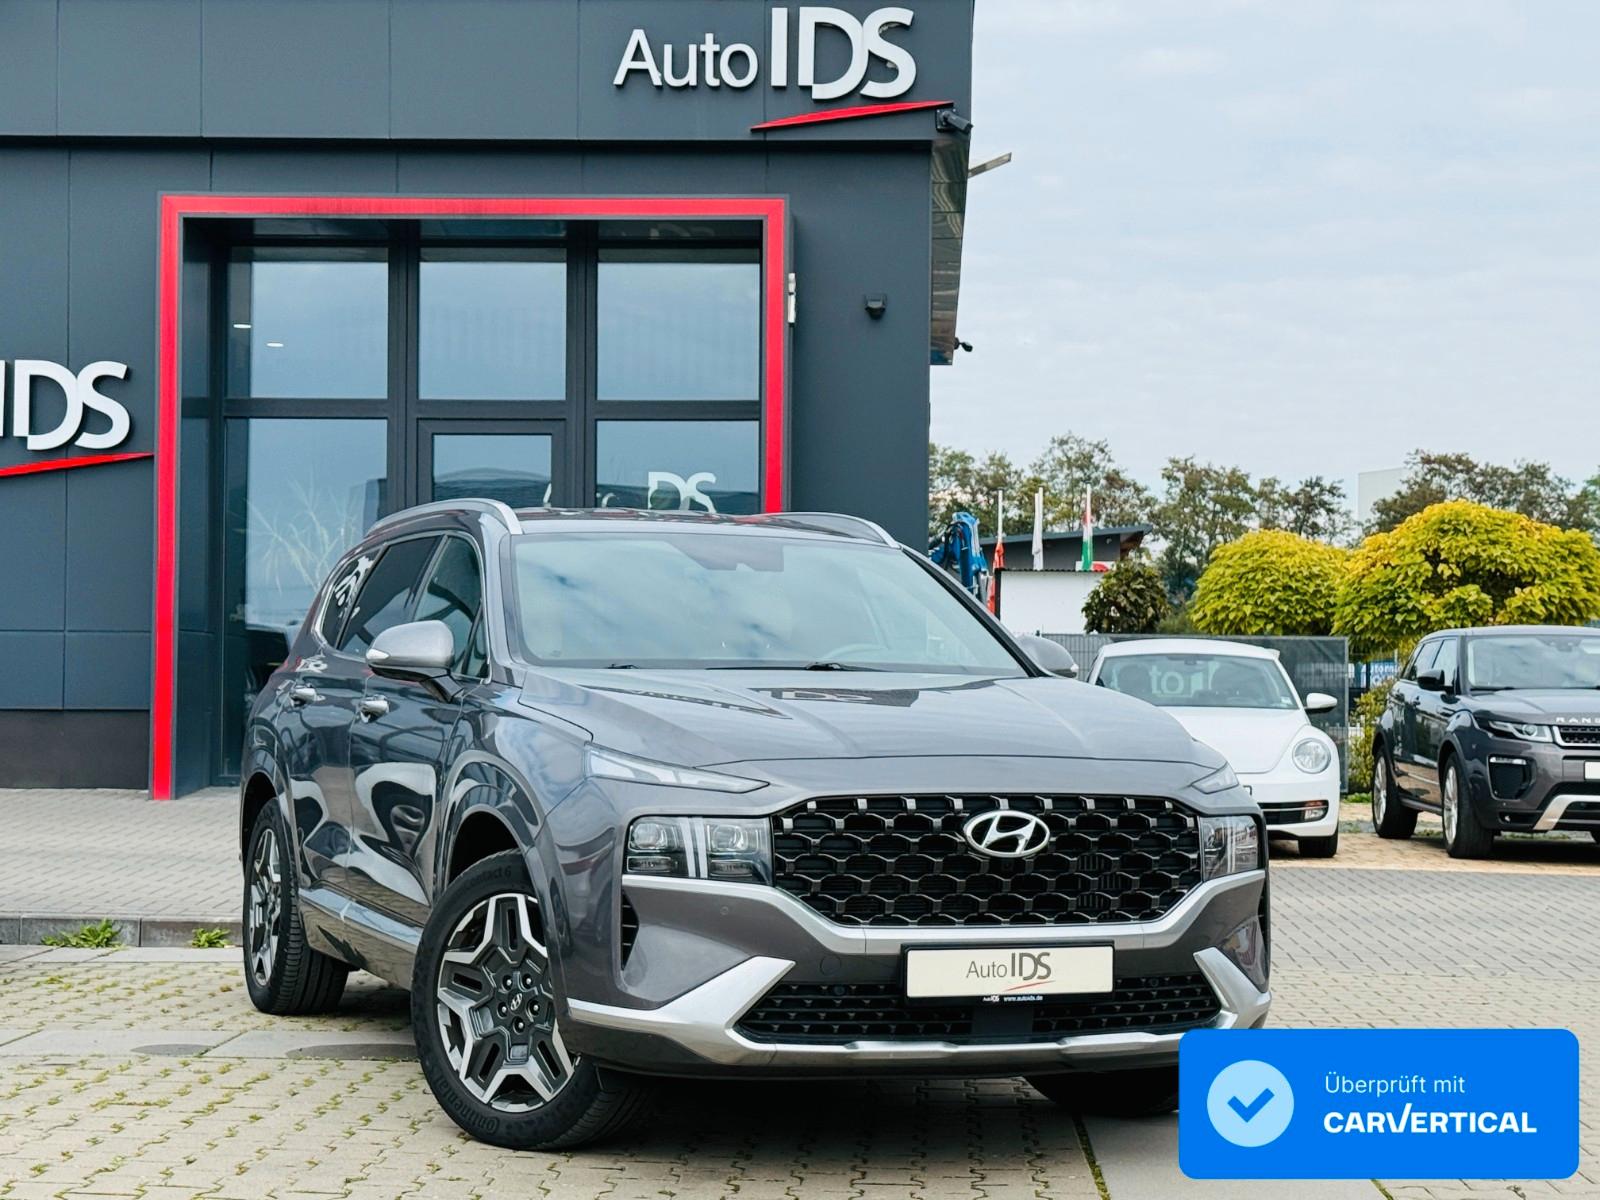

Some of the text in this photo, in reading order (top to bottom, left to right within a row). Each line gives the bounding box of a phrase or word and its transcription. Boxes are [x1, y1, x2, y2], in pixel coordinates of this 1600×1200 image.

[613, 6, 917, 100] Auto IDS
[966, 951, 1052, 981] Auto IDS
[432, 1075, 500, 1135] Continental
